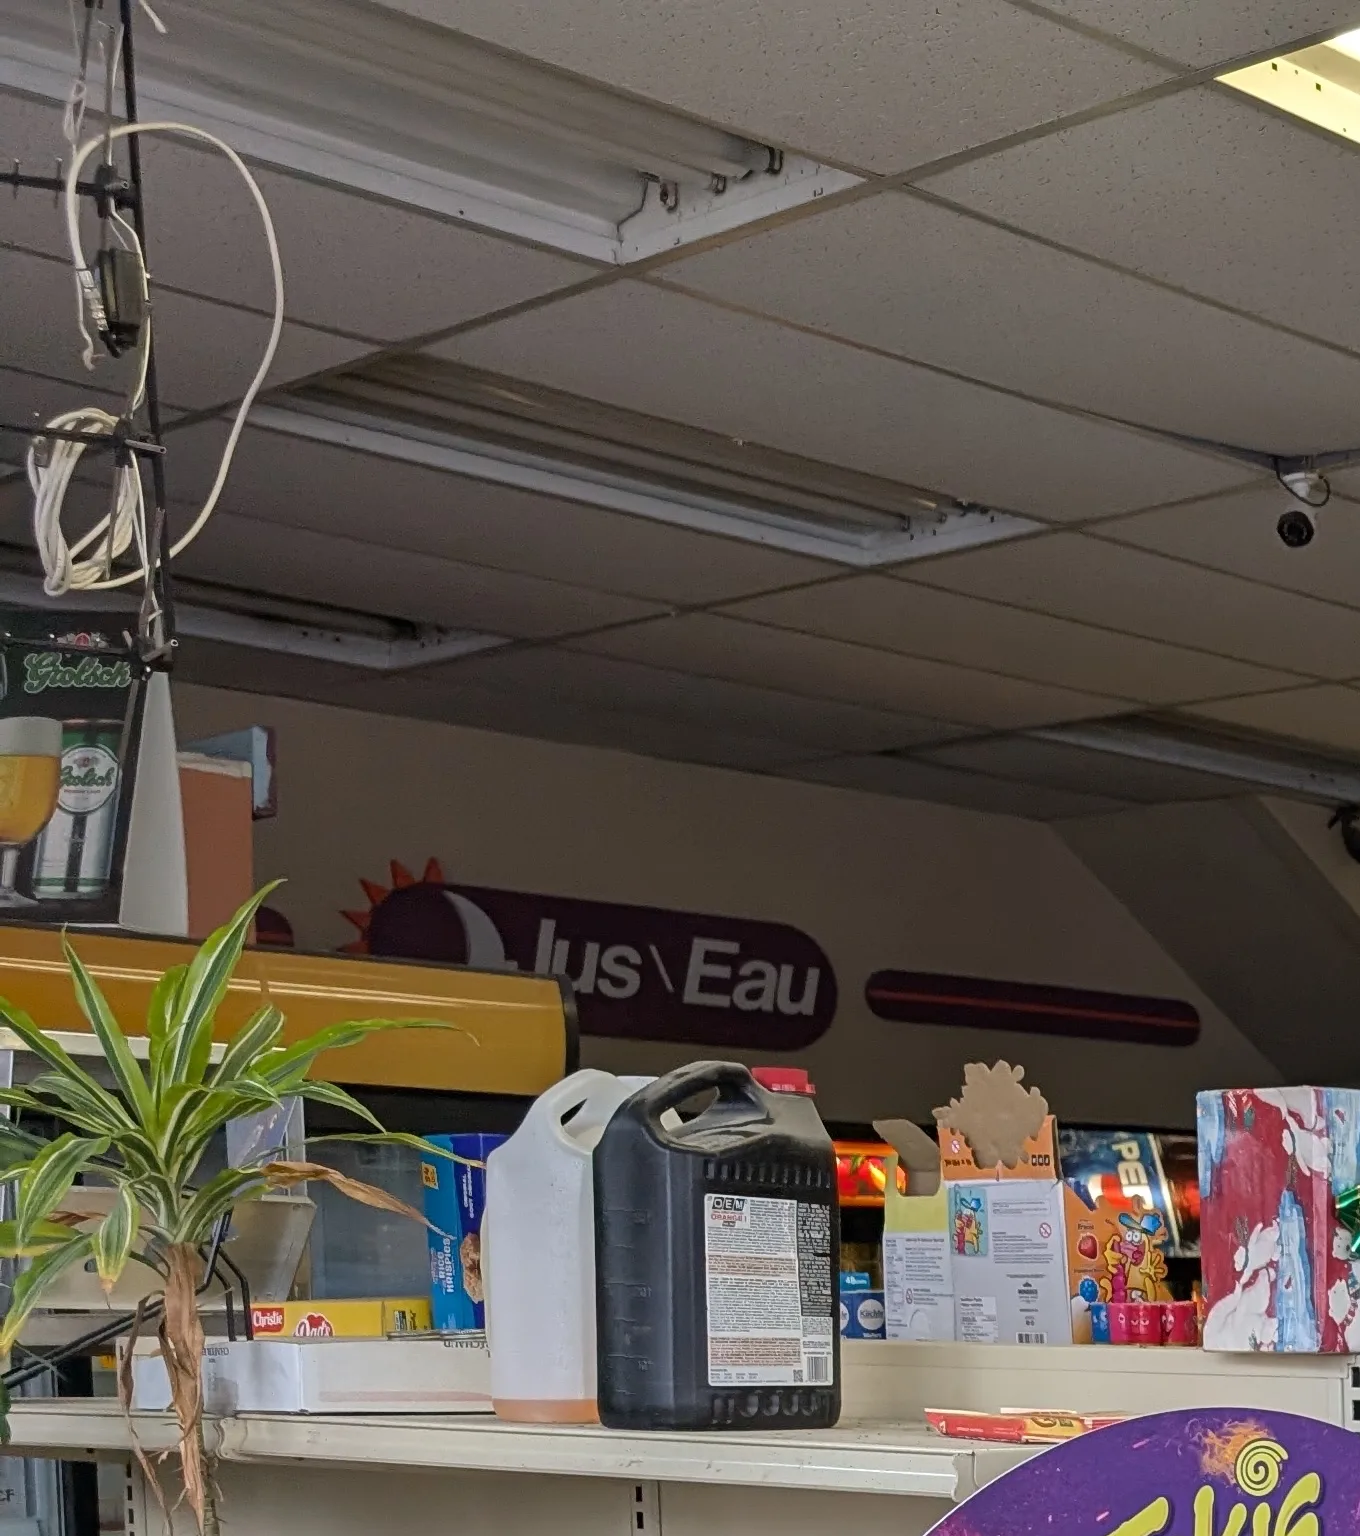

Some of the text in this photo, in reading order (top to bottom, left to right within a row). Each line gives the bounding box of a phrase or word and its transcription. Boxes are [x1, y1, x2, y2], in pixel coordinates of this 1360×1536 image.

[24, 652, 131, 694] Grolsch
[682, 936, 820, 1017] Eau
[711, 1197, 746, 1212] OEM
[252, 1311, 283, 1328] Christie
